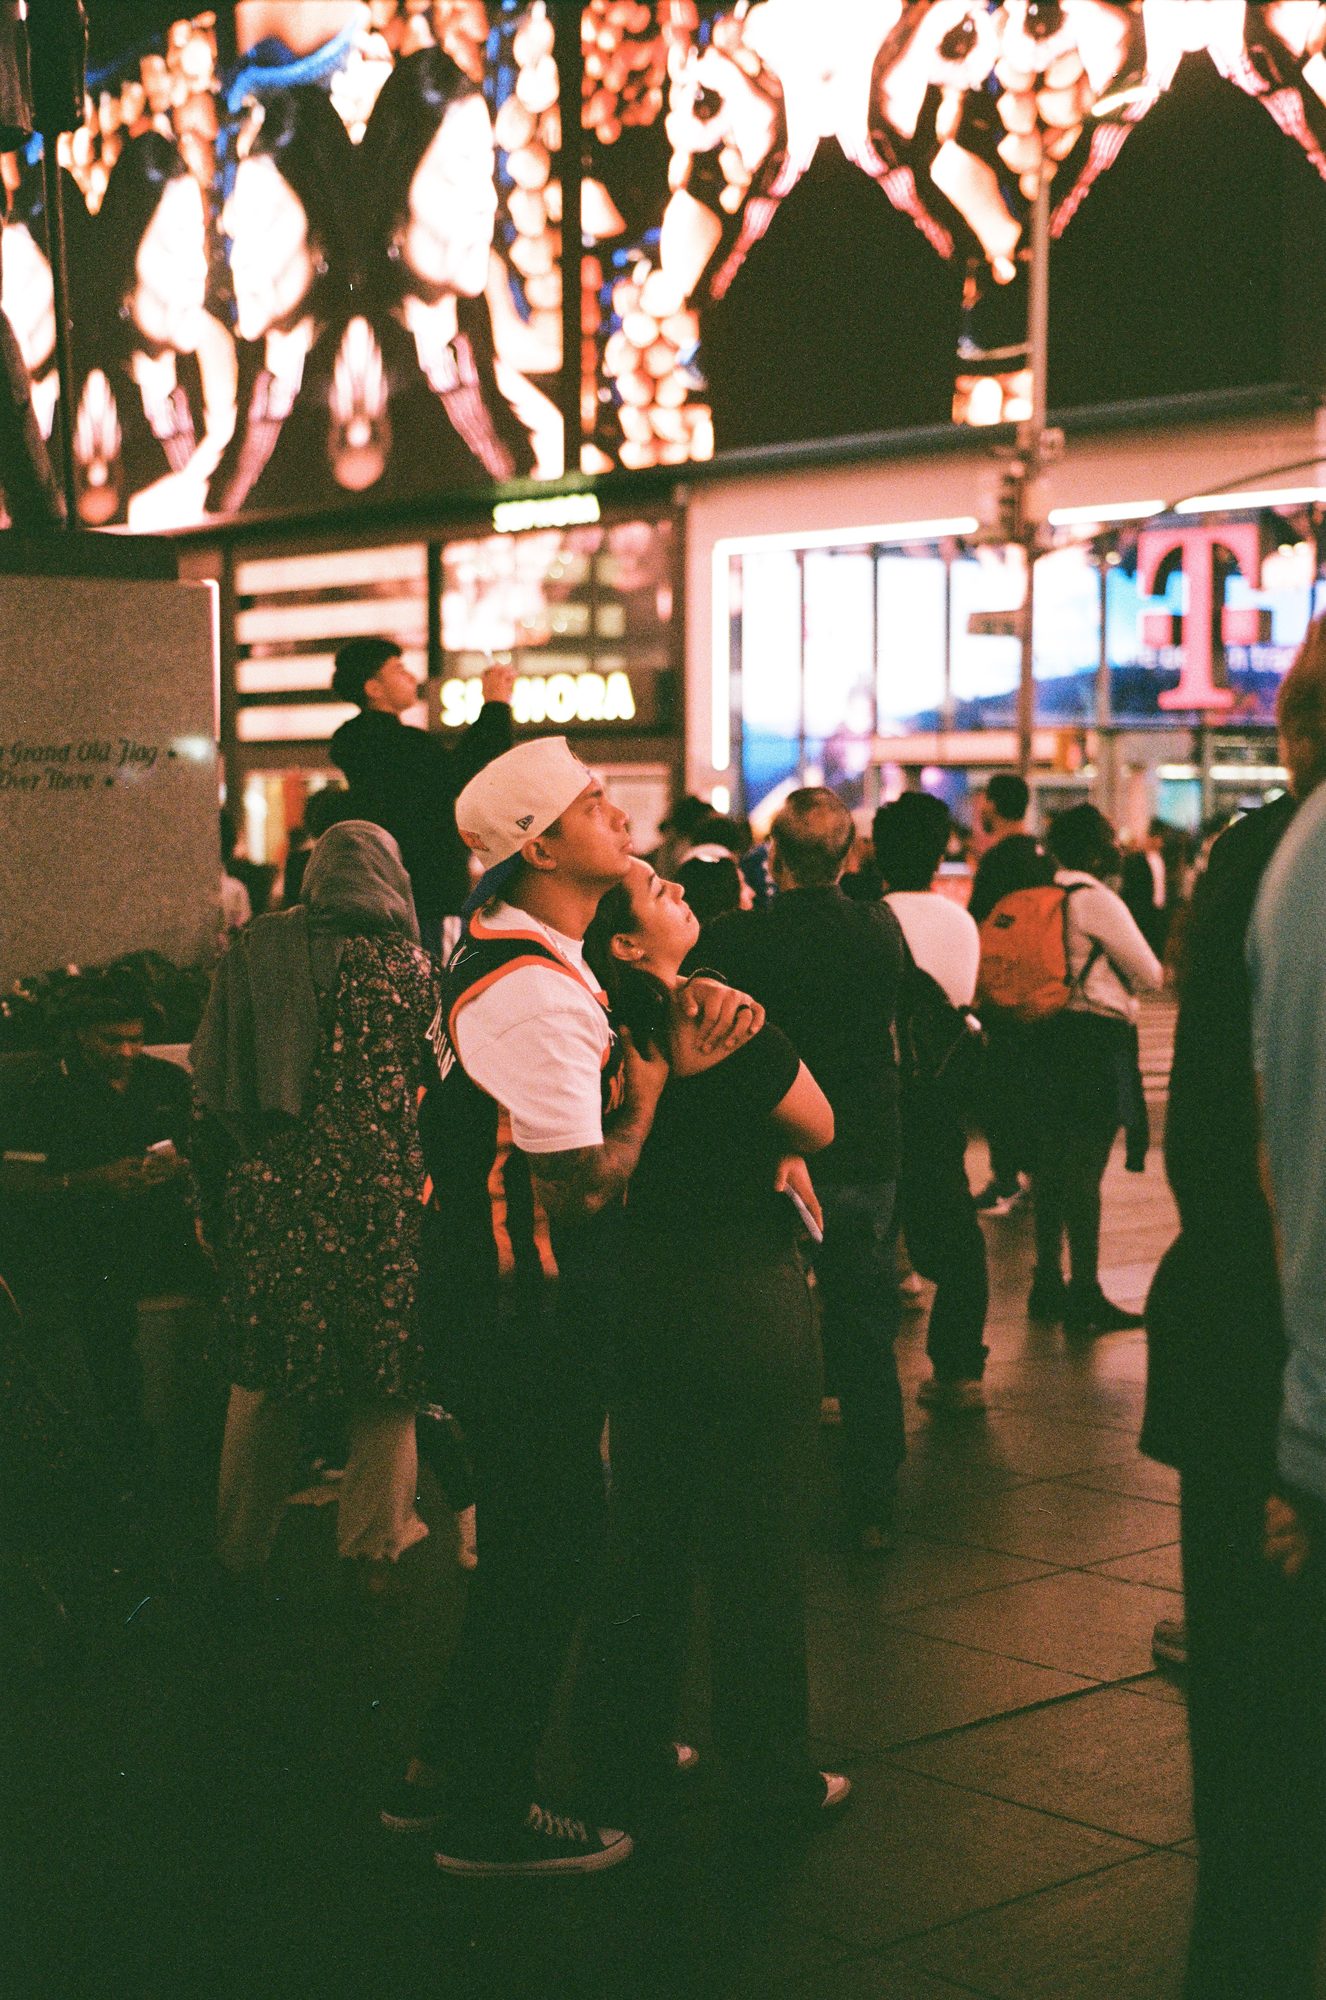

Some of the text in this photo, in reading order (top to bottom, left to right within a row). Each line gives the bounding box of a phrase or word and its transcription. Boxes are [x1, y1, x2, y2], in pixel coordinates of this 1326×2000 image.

[1136, 523, 1261, 711] T
[440, 671, 636, 727] SEHORA
[76, 739, 111, 763] Old
